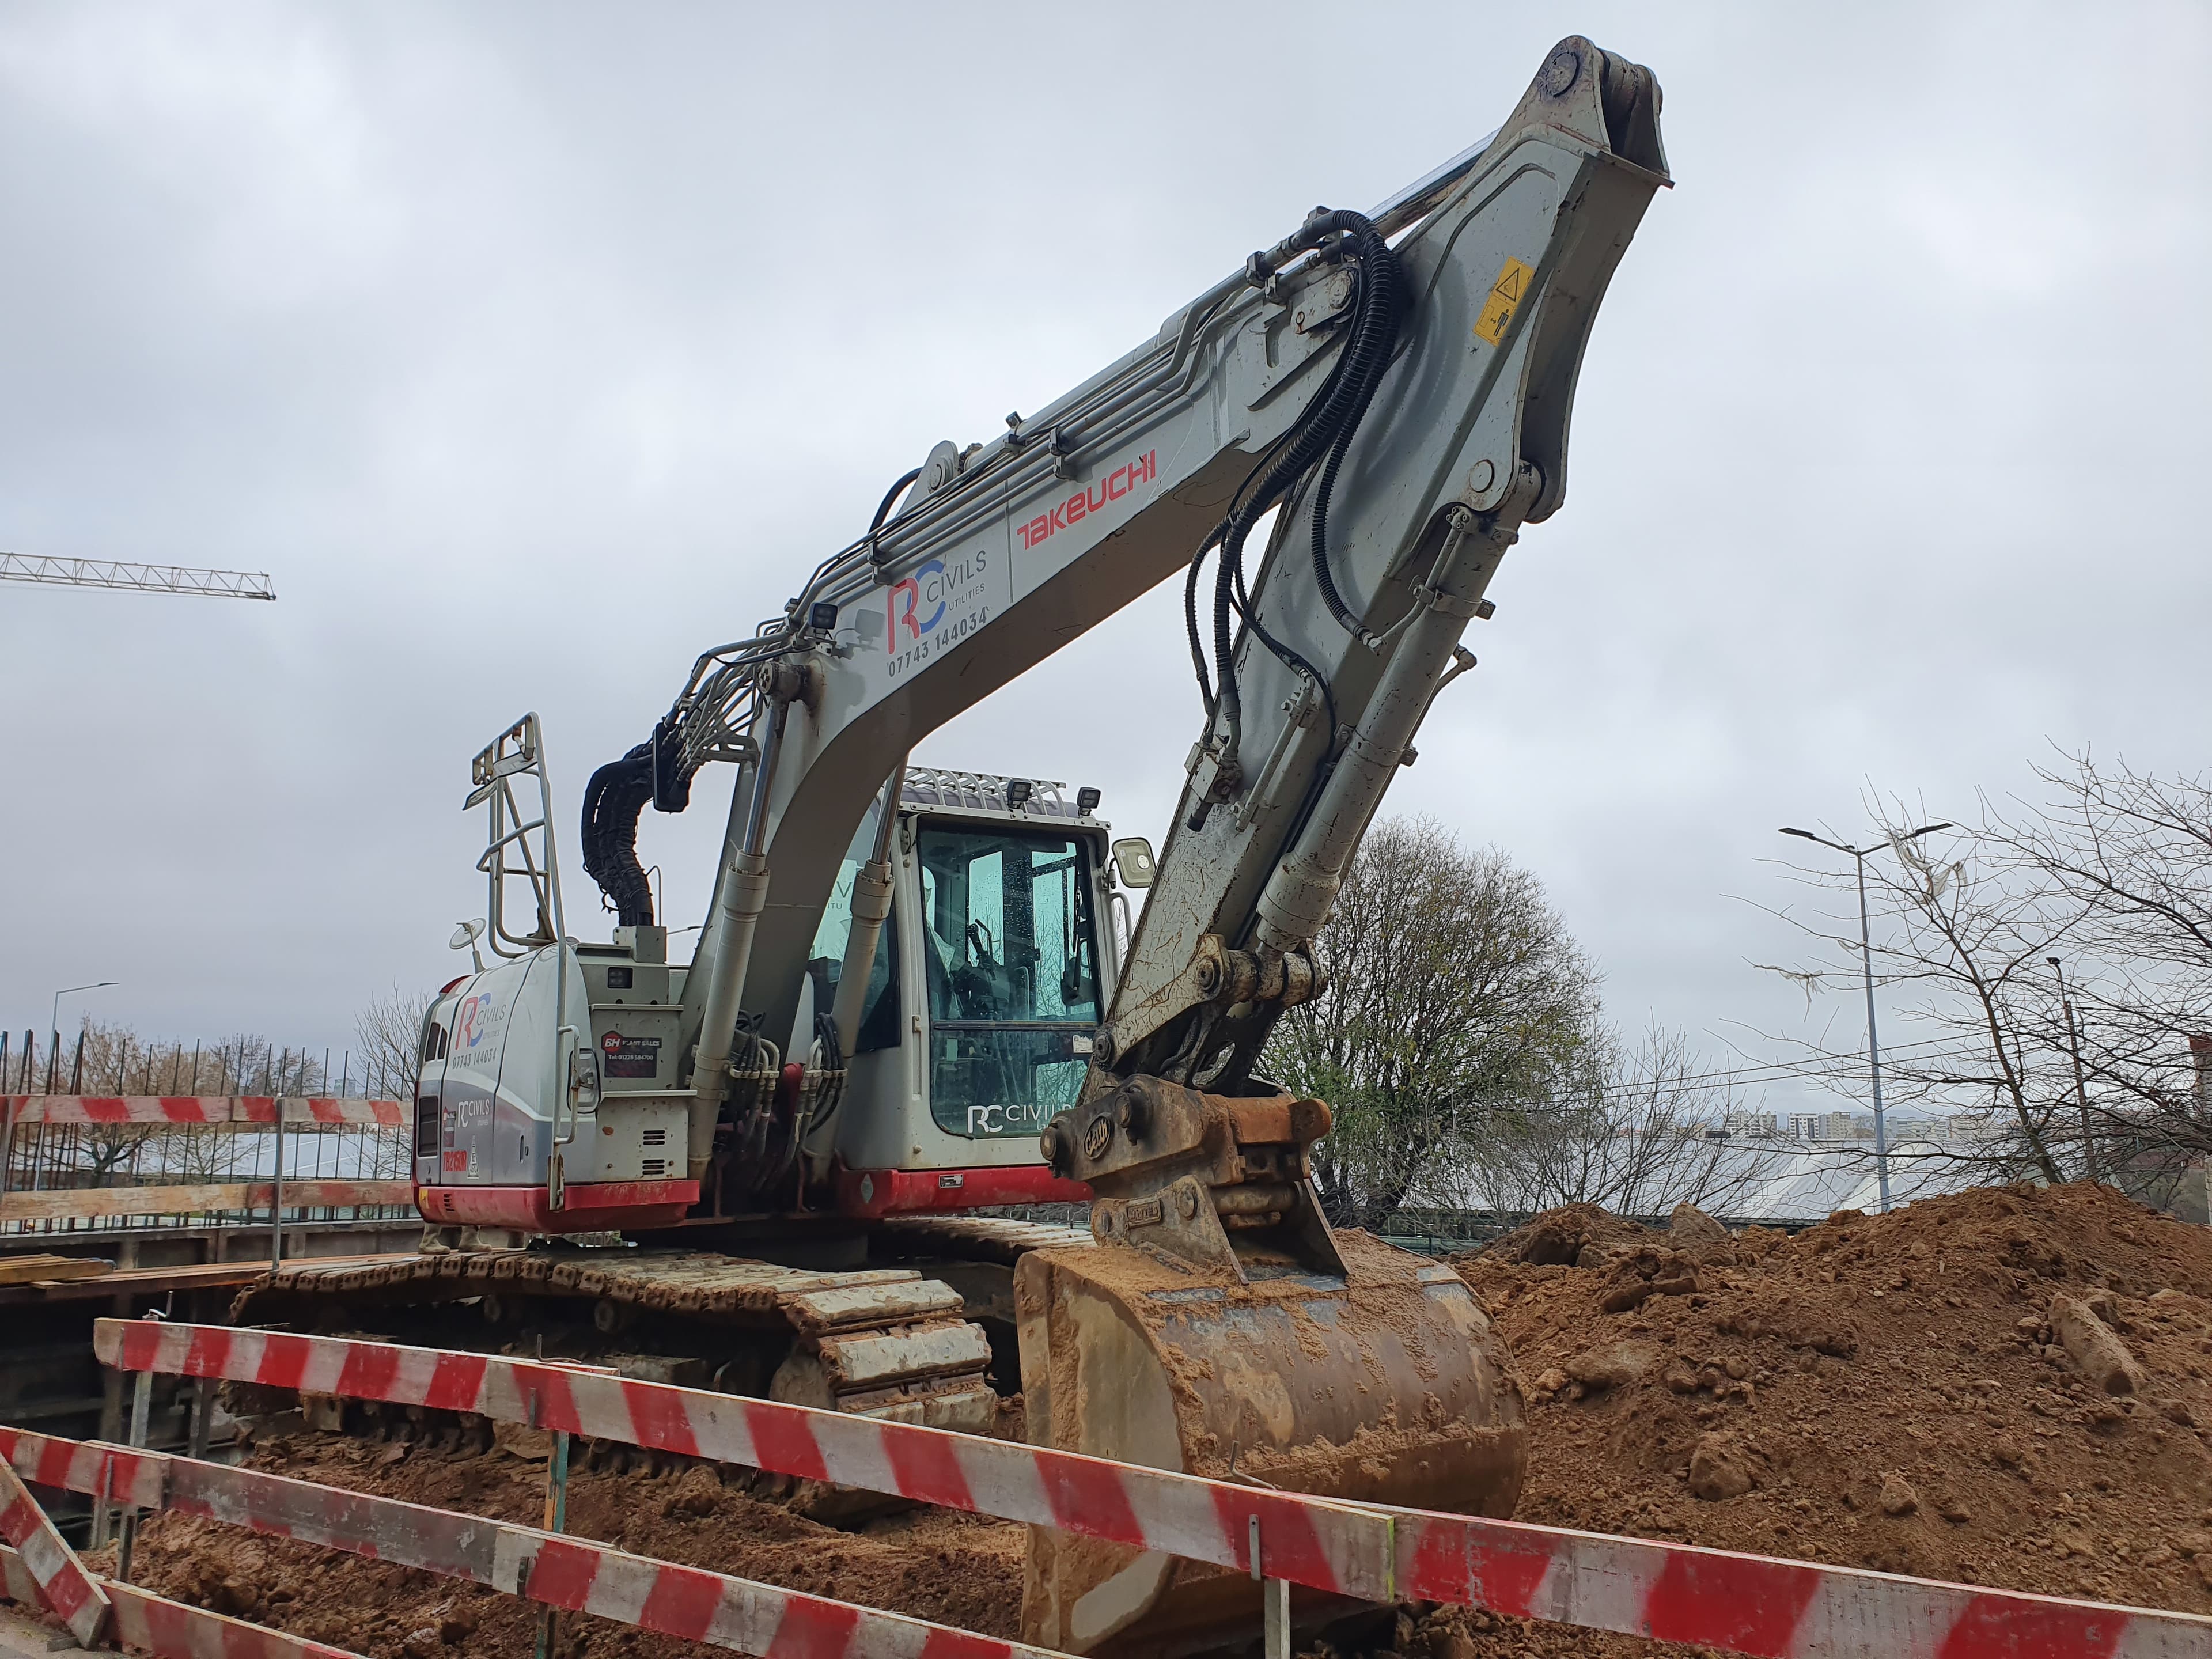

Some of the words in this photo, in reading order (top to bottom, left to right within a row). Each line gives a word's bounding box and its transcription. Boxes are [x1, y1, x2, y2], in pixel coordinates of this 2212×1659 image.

[926, 550, 987, 603] CIVILS
[948, 582, 986, 611] UTILITIES
[888, 640, 929, 678] 07743
[935, 606, 987, 651] 144034
[476, 1004, 507, 1026] CIVILS
[604, 1038, 620, 1047] BH
[452, 1053, 471, 1070] 07743
[473, 1047, 497, 1065] 144034
[468, 1099, 490, 1117] CIVILS
